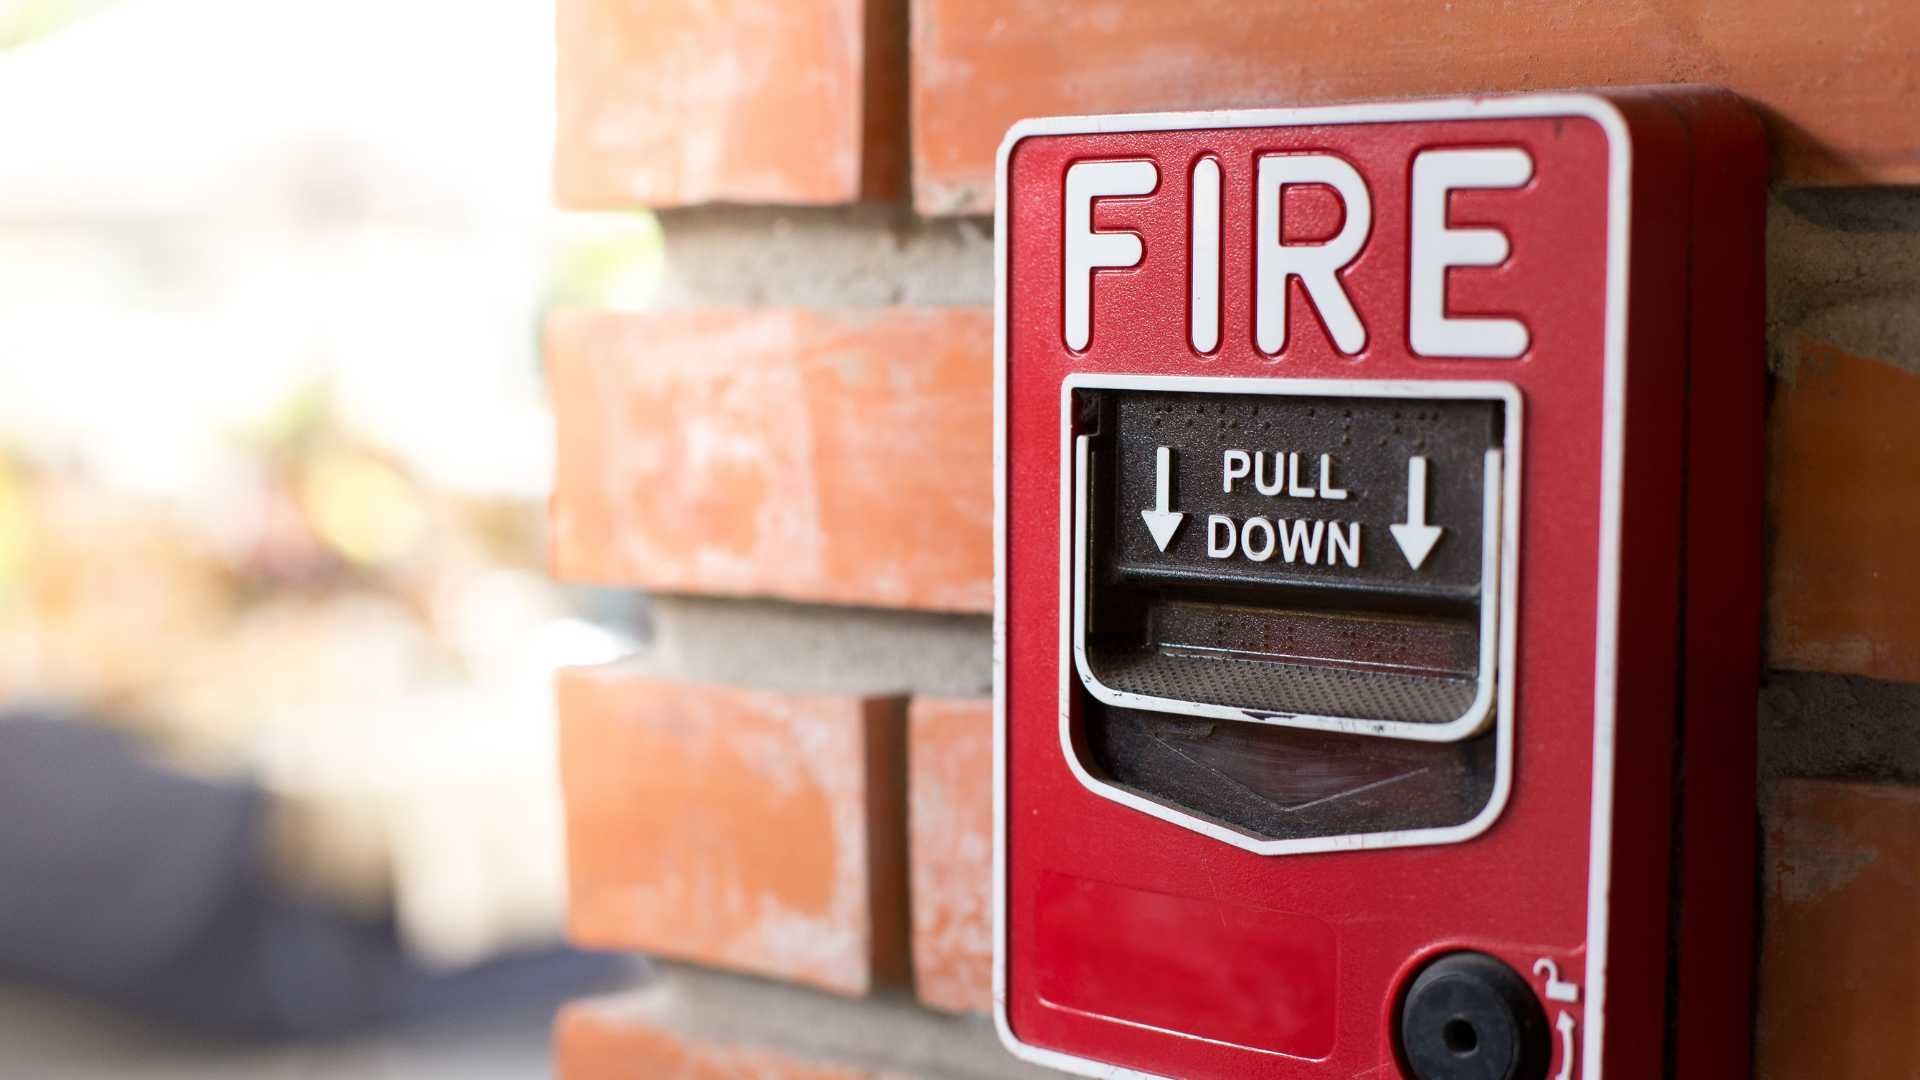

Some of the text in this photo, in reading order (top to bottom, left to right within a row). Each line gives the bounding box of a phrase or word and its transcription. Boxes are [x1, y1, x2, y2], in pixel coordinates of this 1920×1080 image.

[1064, 147, 1535, 358] FIRE
[1223, 449, 1348, 500] PULL
[1207, 515, 1361, 568] DOWN
